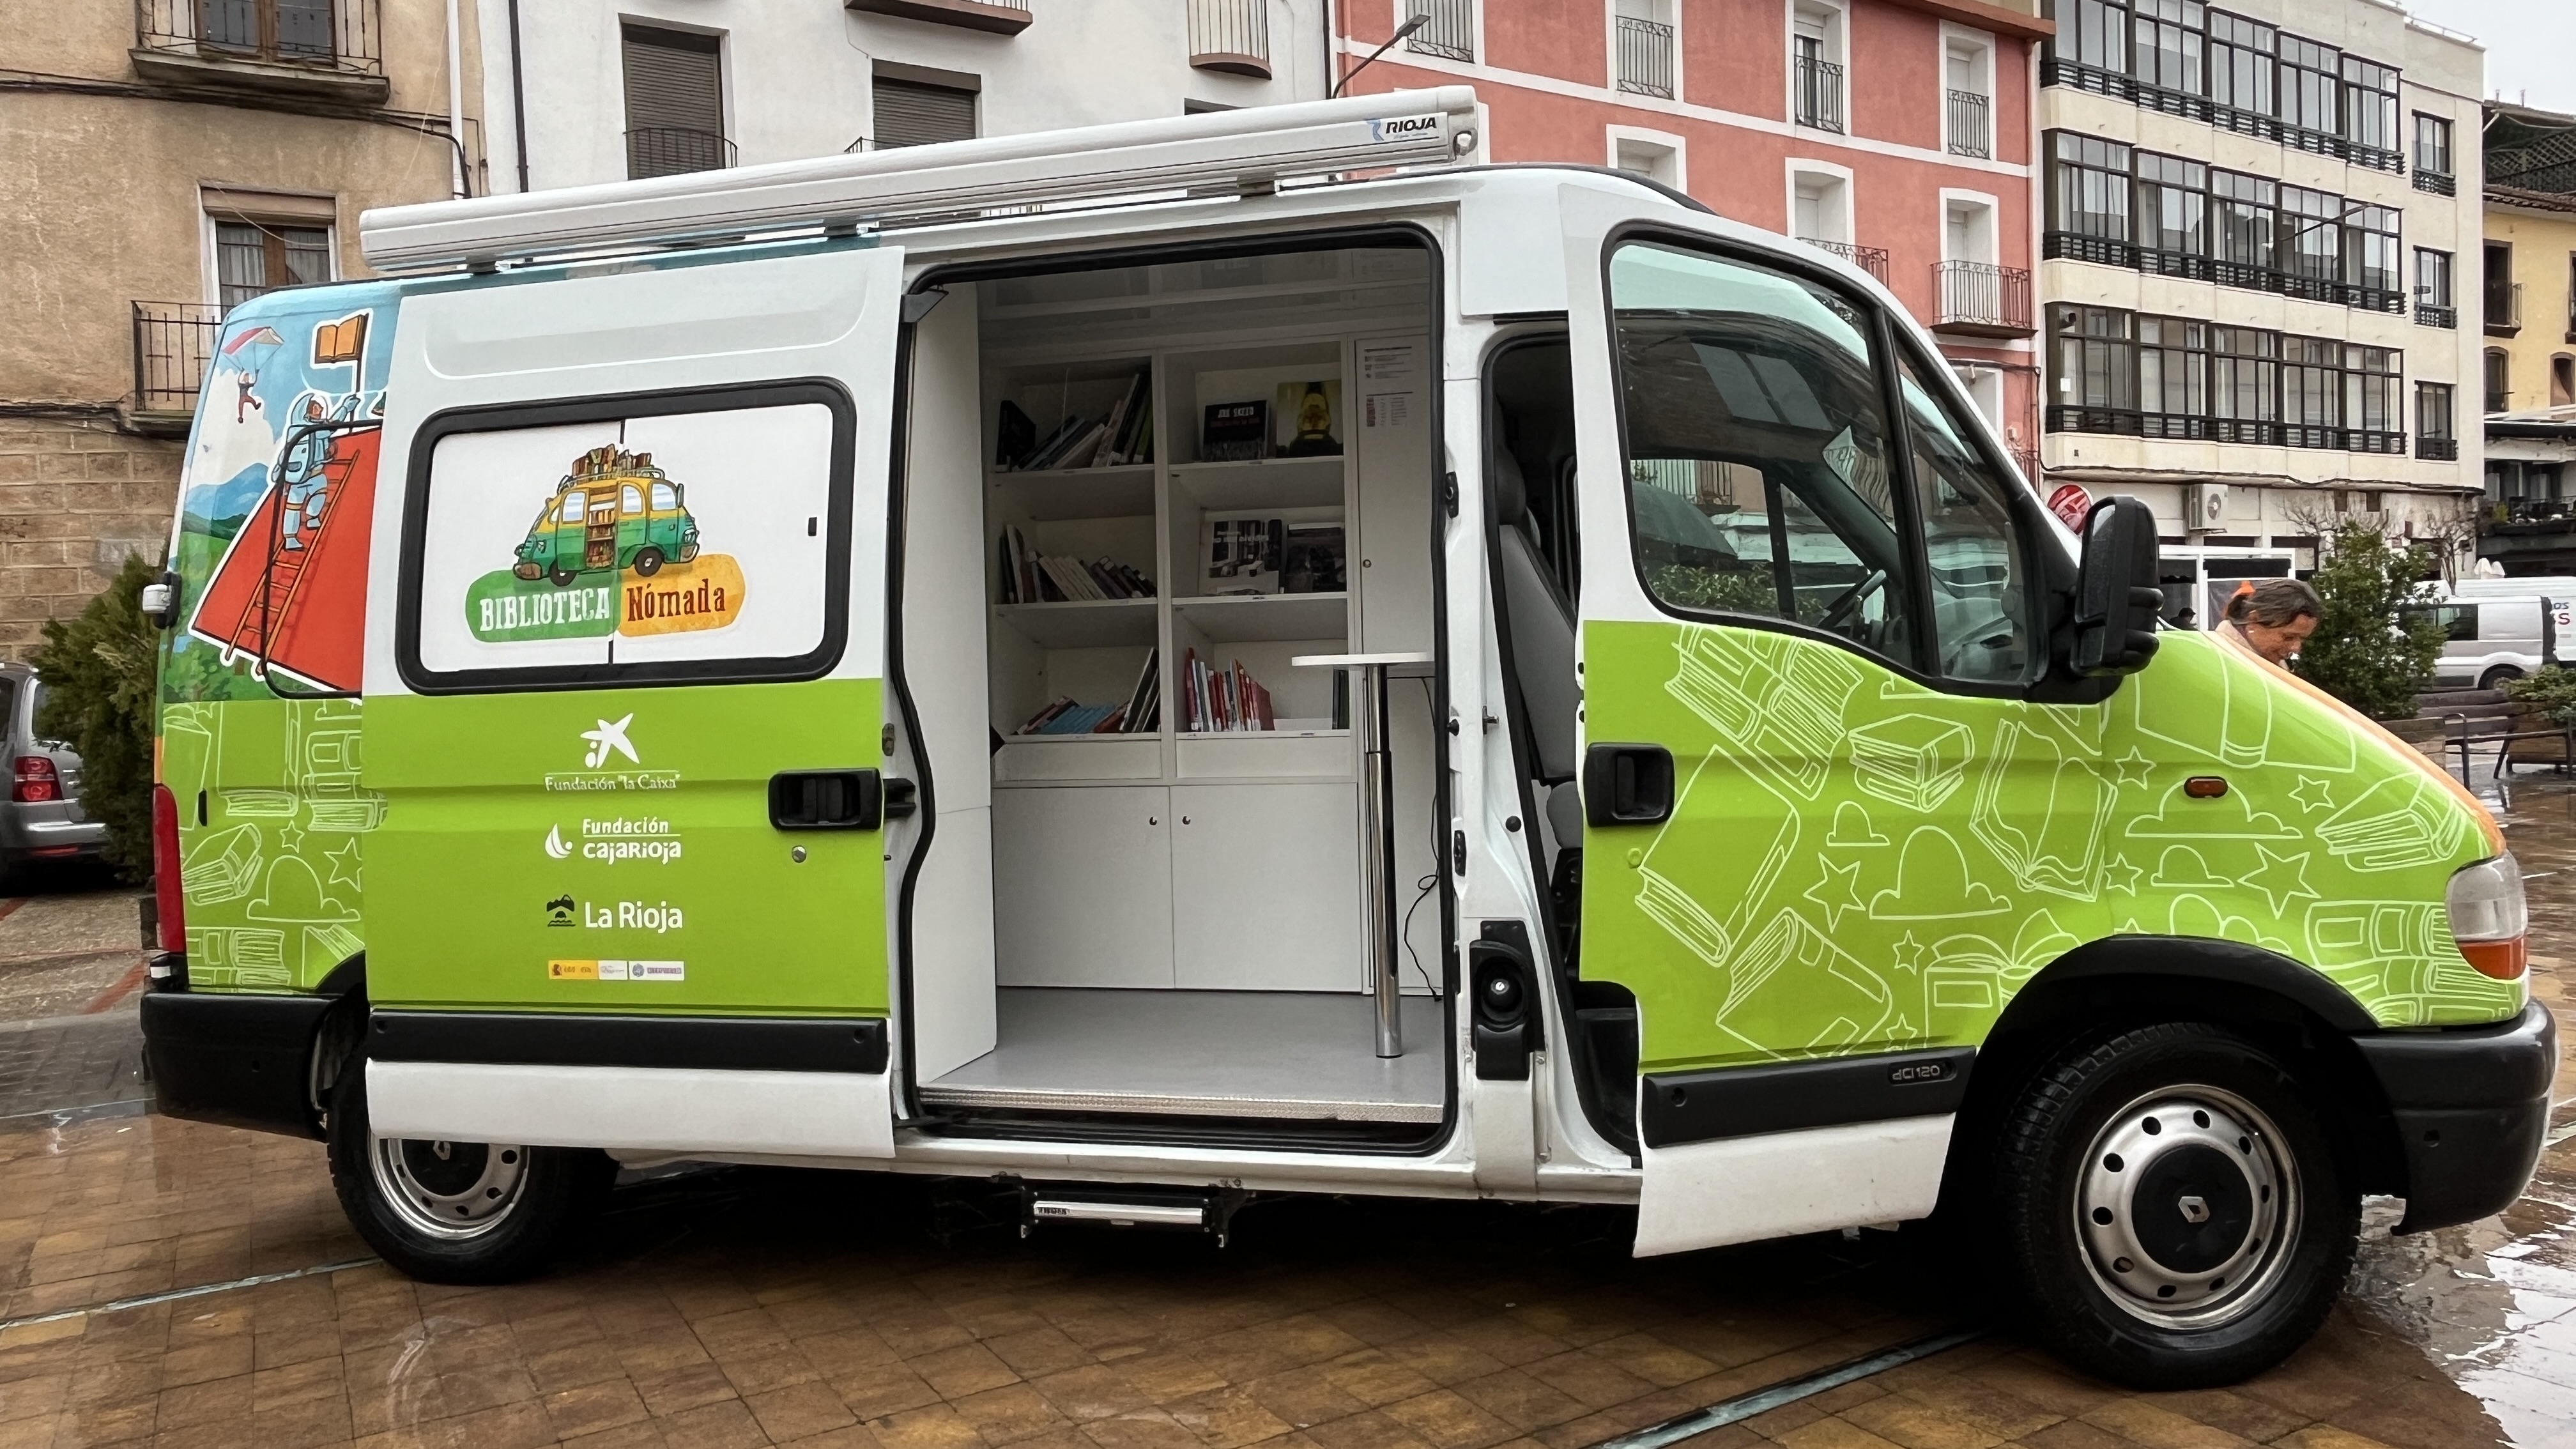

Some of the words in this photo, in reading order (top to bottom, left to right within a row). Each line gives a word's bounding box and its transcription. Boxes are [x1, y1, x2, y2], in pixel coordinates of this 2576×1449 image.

[1386, 117, 1437, 134] RIOJA
[479, 587, 611, 632] BIBLIOTECA
[626, 578, 726, 622] Nómada
[544, 776, 617, 791] Fundación
[637, 773, 681, 790] Caixa"
[582, 816, 669, 834] Fundación
[585, 901, 613, 928] La
[618, 900, 684, 934] Rioja
[1916, 1065, 1940, 1078] 120
